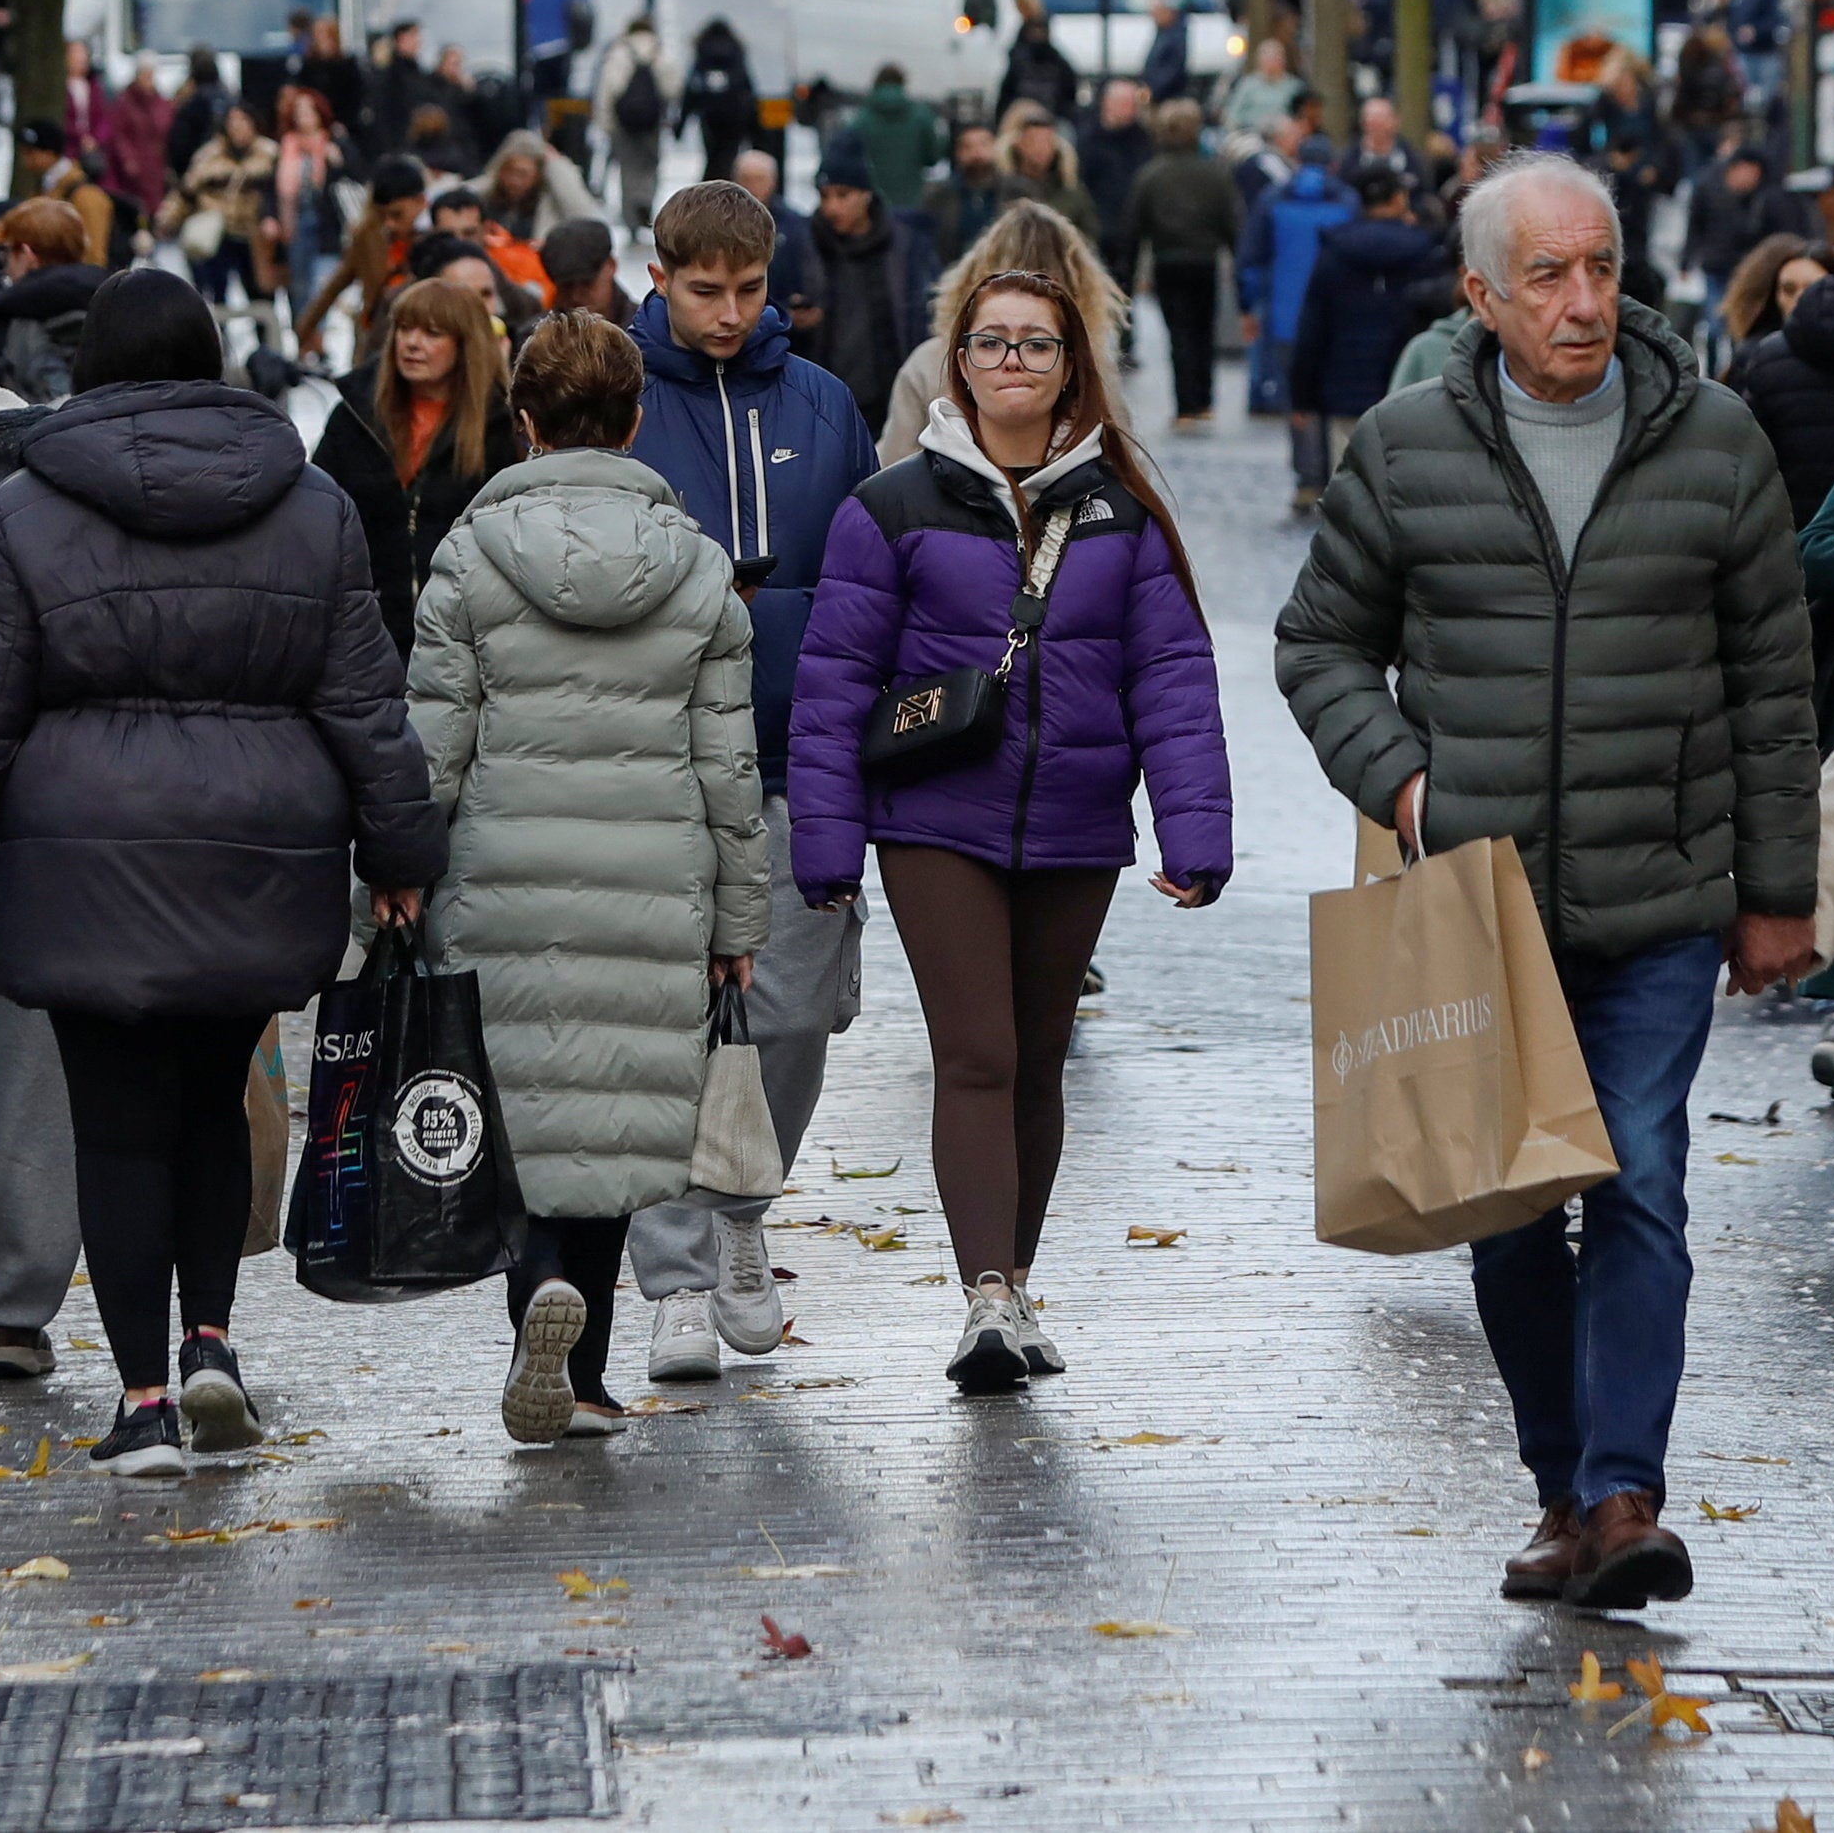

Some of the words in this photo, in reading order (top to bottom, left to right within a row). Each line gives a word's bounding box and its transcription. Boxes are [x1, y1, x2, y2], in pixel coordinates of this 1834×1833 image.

[422, 1107, 456, 1129] 85%
[467, 1110, 481, 1149] REUSE
[401, 1133, 439, 1170] RECYCLE
